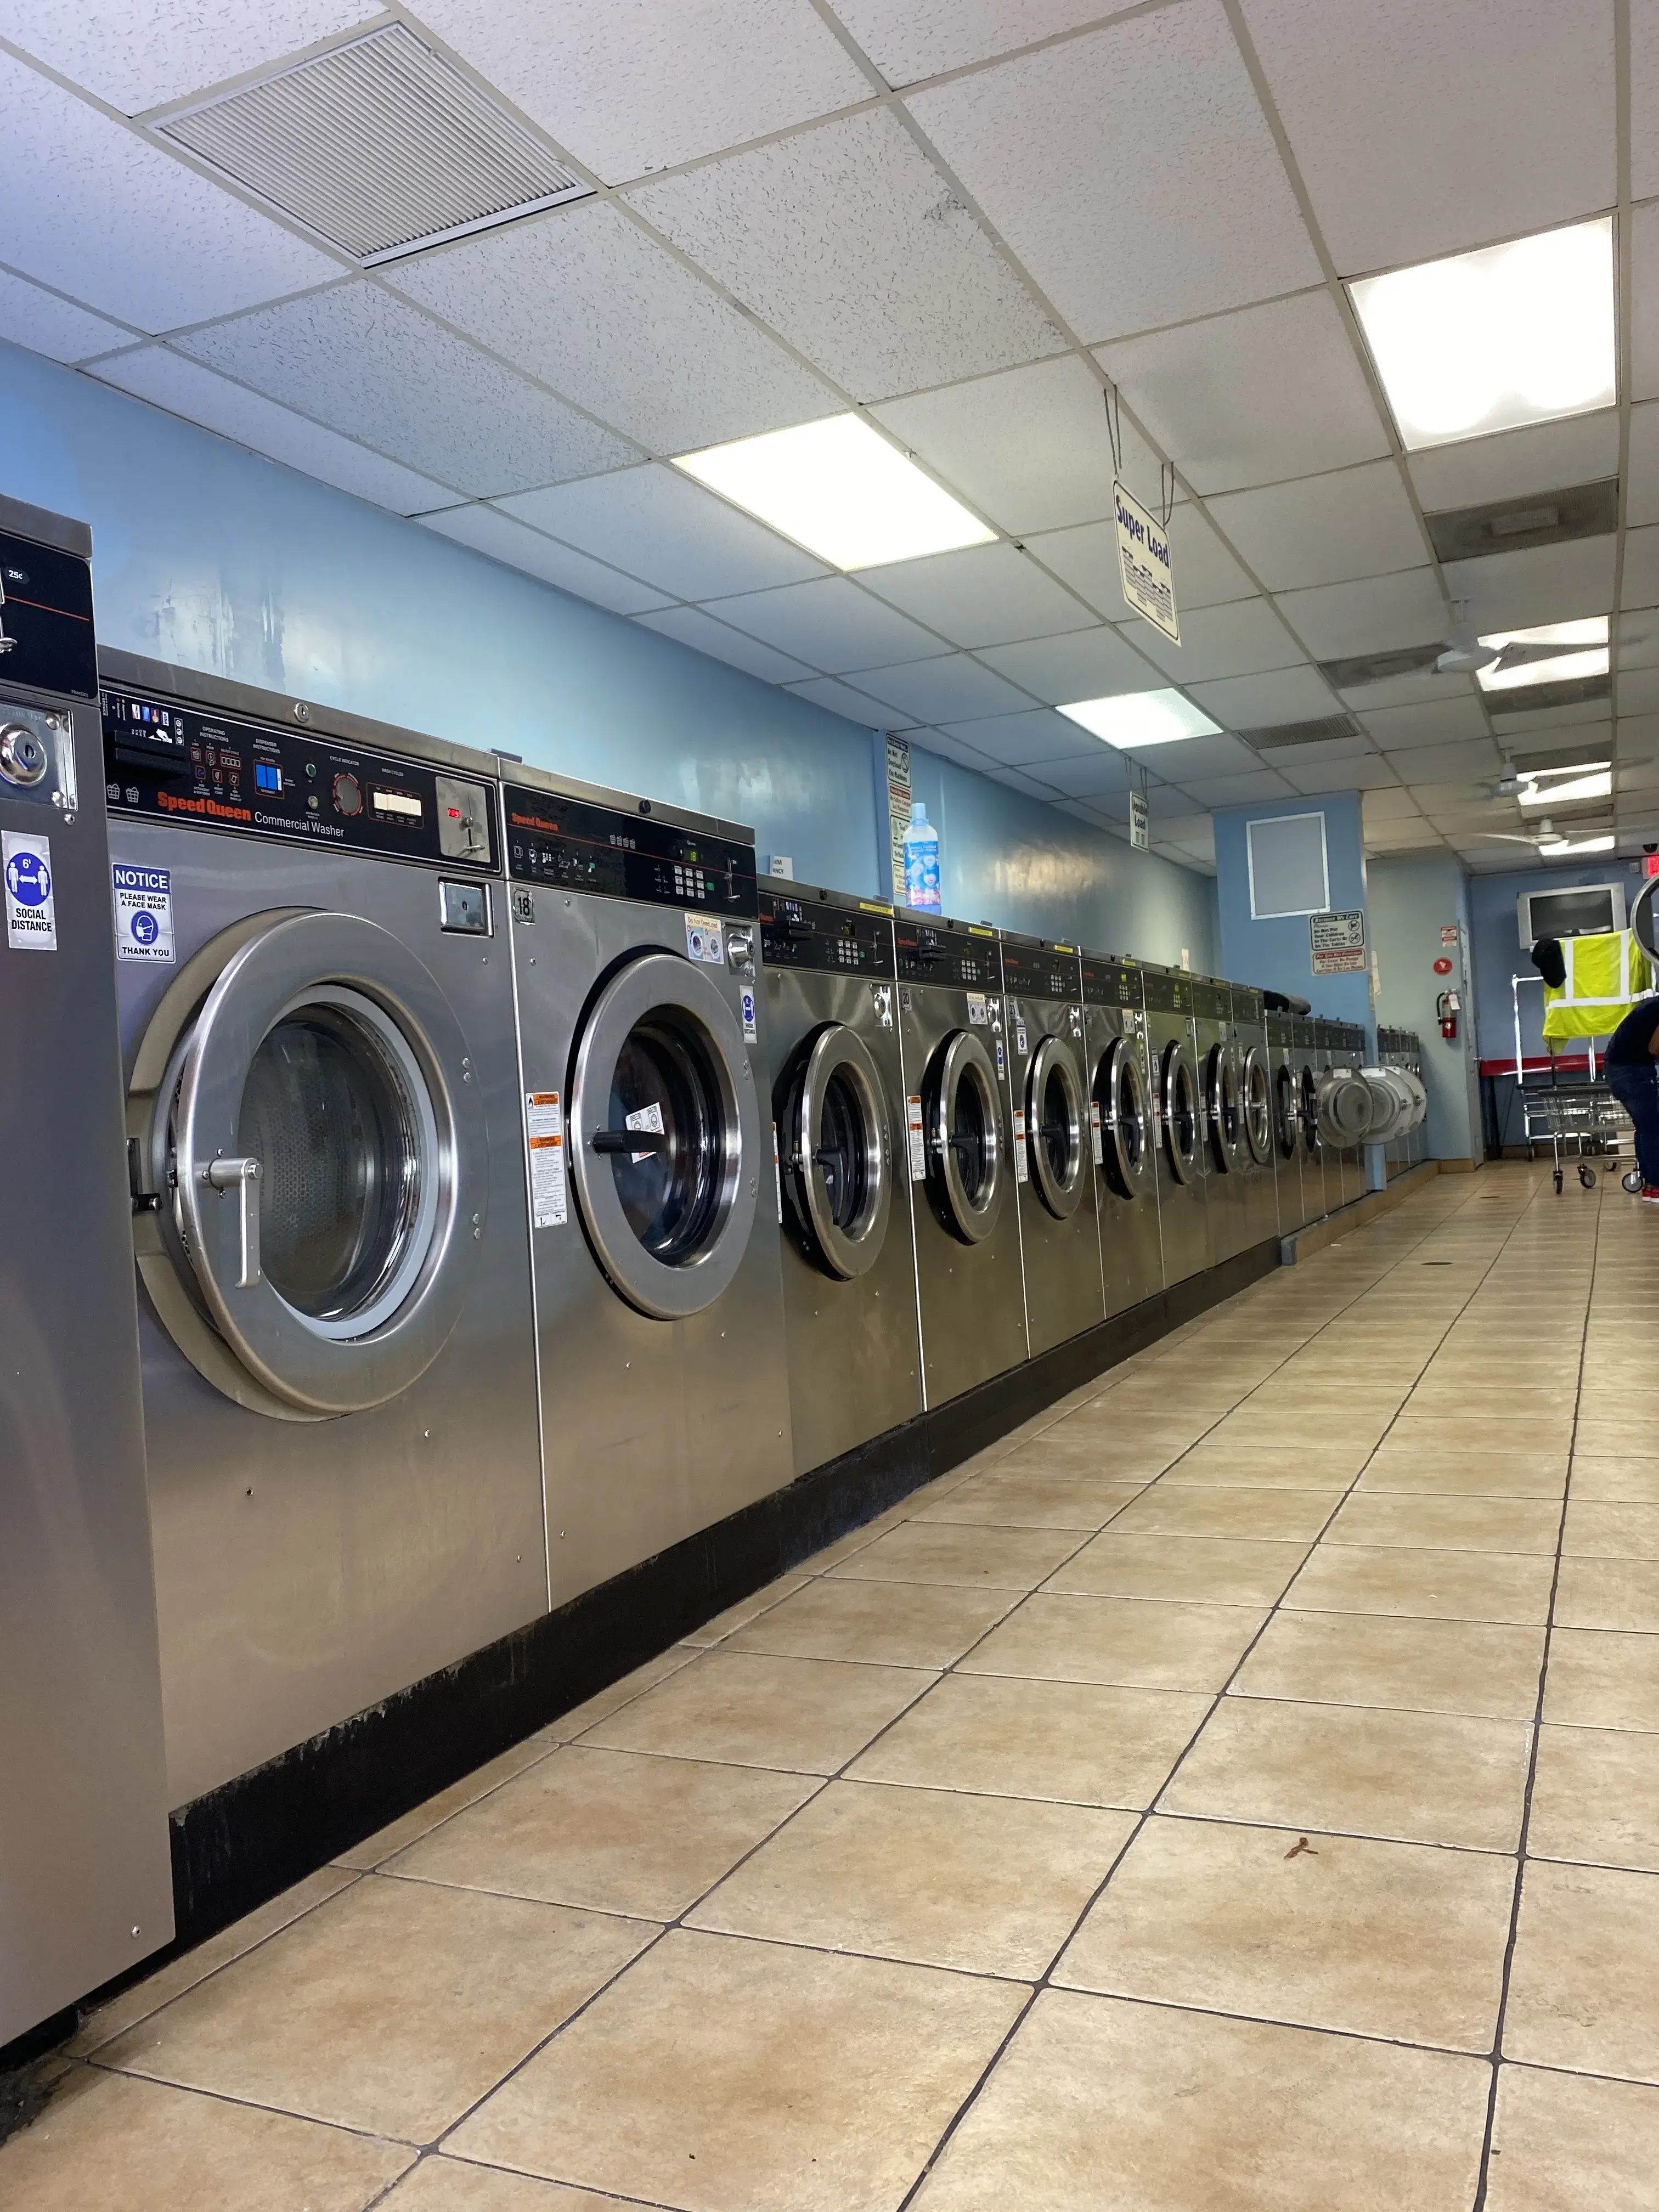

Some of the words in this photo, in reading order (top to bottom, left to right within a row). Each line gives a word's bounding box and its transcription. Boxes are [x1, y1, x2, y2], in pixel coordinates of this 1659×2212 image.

[1115, 494, 1144, 545] Super
[1147, 525, 1170, 569] Load
[202, 726, 225, 735] OPERATING
[199, 732, 229, 742] INSTRUCTIONS
[253, 744, 280, 754] INSTRUCTIONS
[157, 792, 205, 814] Speed
[207, 798, 252, 821] Queen
[255, 811, 309, 831] Commercial
[311, 821, 345, 837] Washer
[511, 812, 535, 826] Speed
[536, 817, 558, 831] Queen
[115, 870, 168, 889] NOTICE
[120, 893, 145, 901] PLEASE
[517, 897, 529, 916] 18
[16, 908, 47, 920] SOCIAL
[12, 919, 53, 933] DISTANCE
[122, 946, 151, 956] THANK
[154, 949, 170, 957] YOU
[903, 993, 909, 1004] 20
